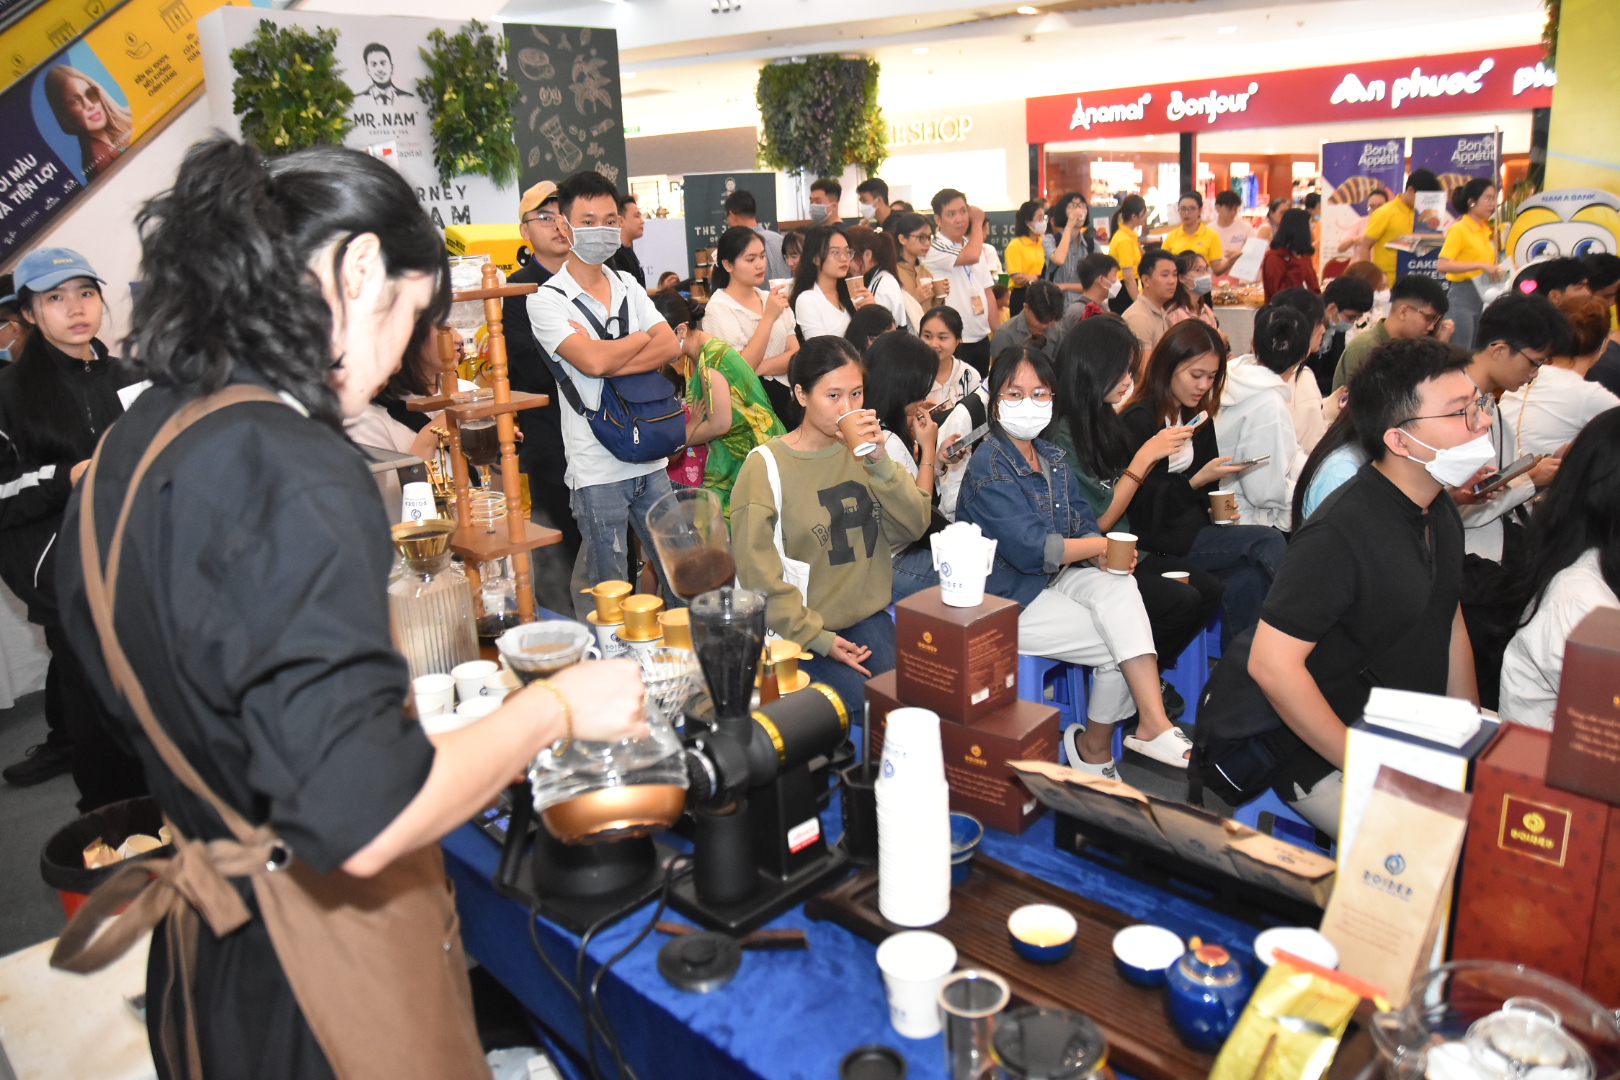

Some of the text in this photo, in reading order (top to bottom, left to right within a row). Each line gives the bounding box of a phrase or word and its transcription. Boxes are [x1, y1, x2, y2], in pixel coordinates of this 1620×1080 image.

[1166, 81, 1260, 124] Bonjour
[416, 184, 467, 202] RNEY
[694, 225, 716, 236] THE
